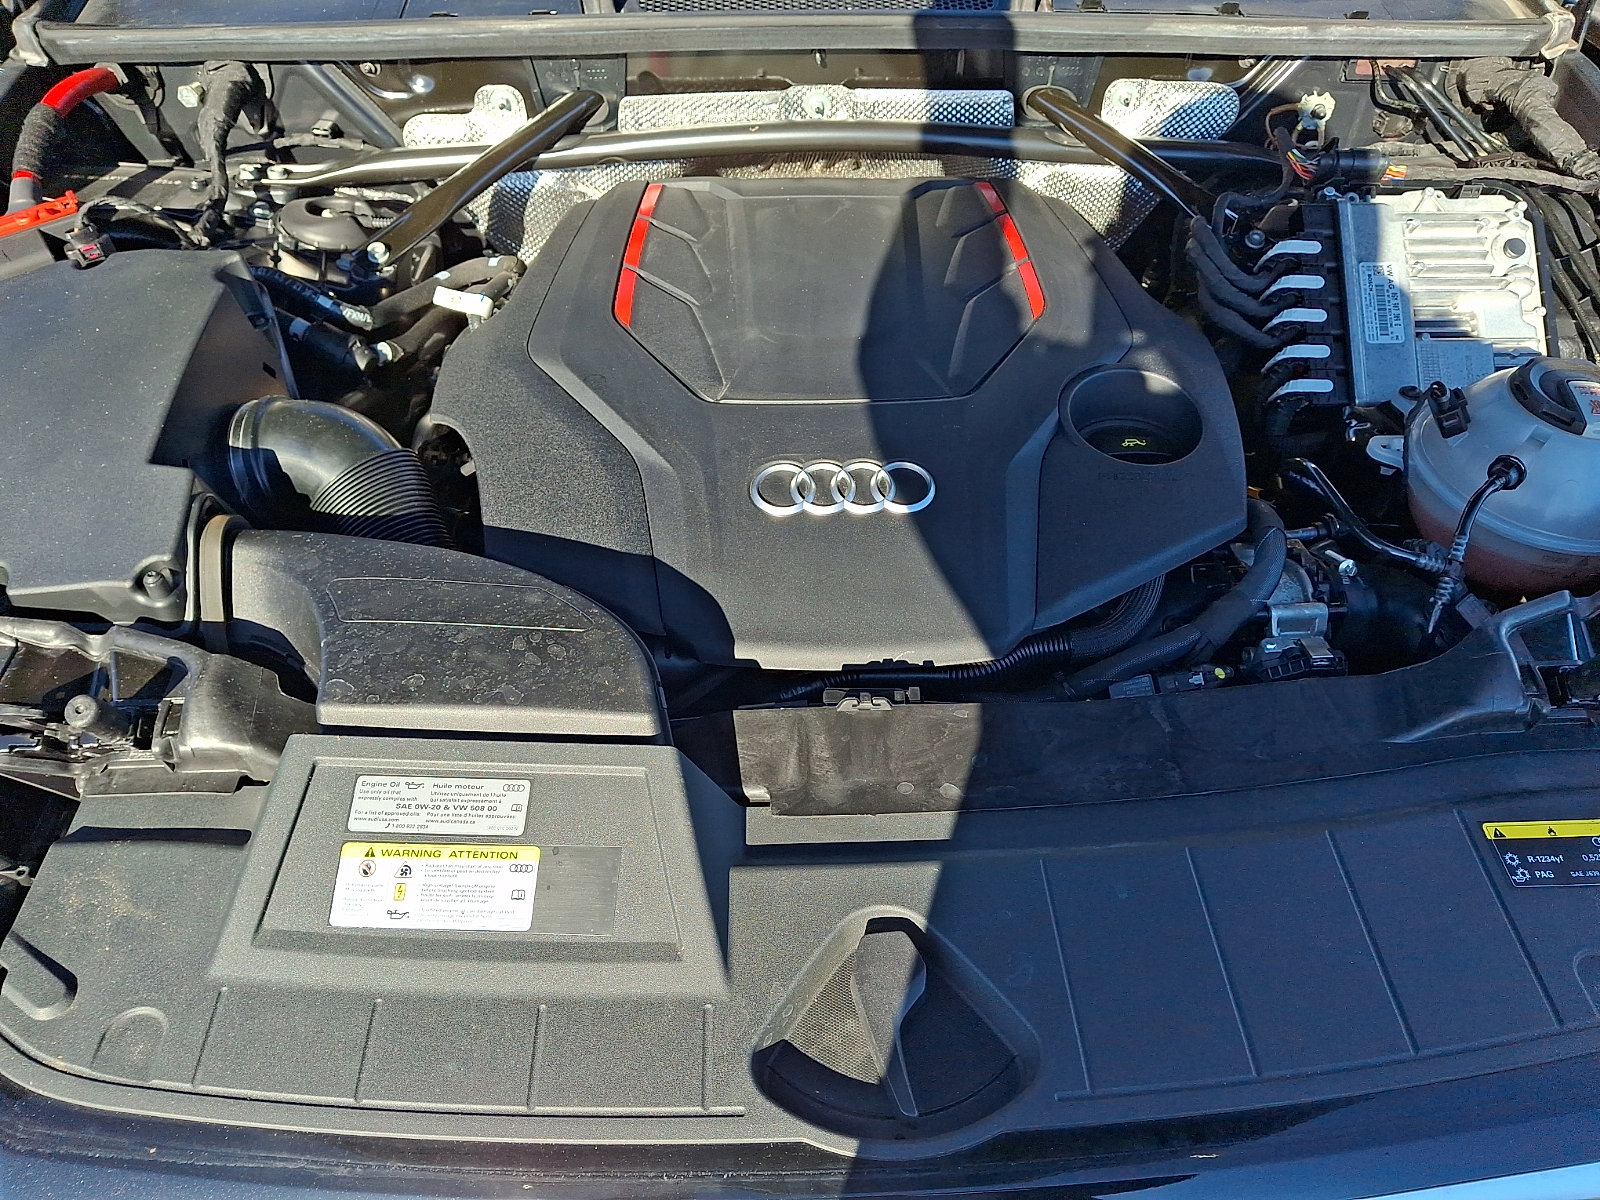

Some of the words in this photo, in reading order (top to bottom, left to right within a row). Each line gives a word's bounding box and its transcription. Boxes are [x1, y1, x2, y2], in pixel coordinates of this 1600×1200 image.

[1387, 264, 1393, 276] VW
[1387, 278, 1395, 290] AG
[361, 780, 388, 788] Engine
[381, 849, 442, 858] WARNING
[448, 850, 519, 860] ATTENTION
[1527, 855, 1564, 864] R-1234yf
[1534, 870, 1555, 878] PAG
